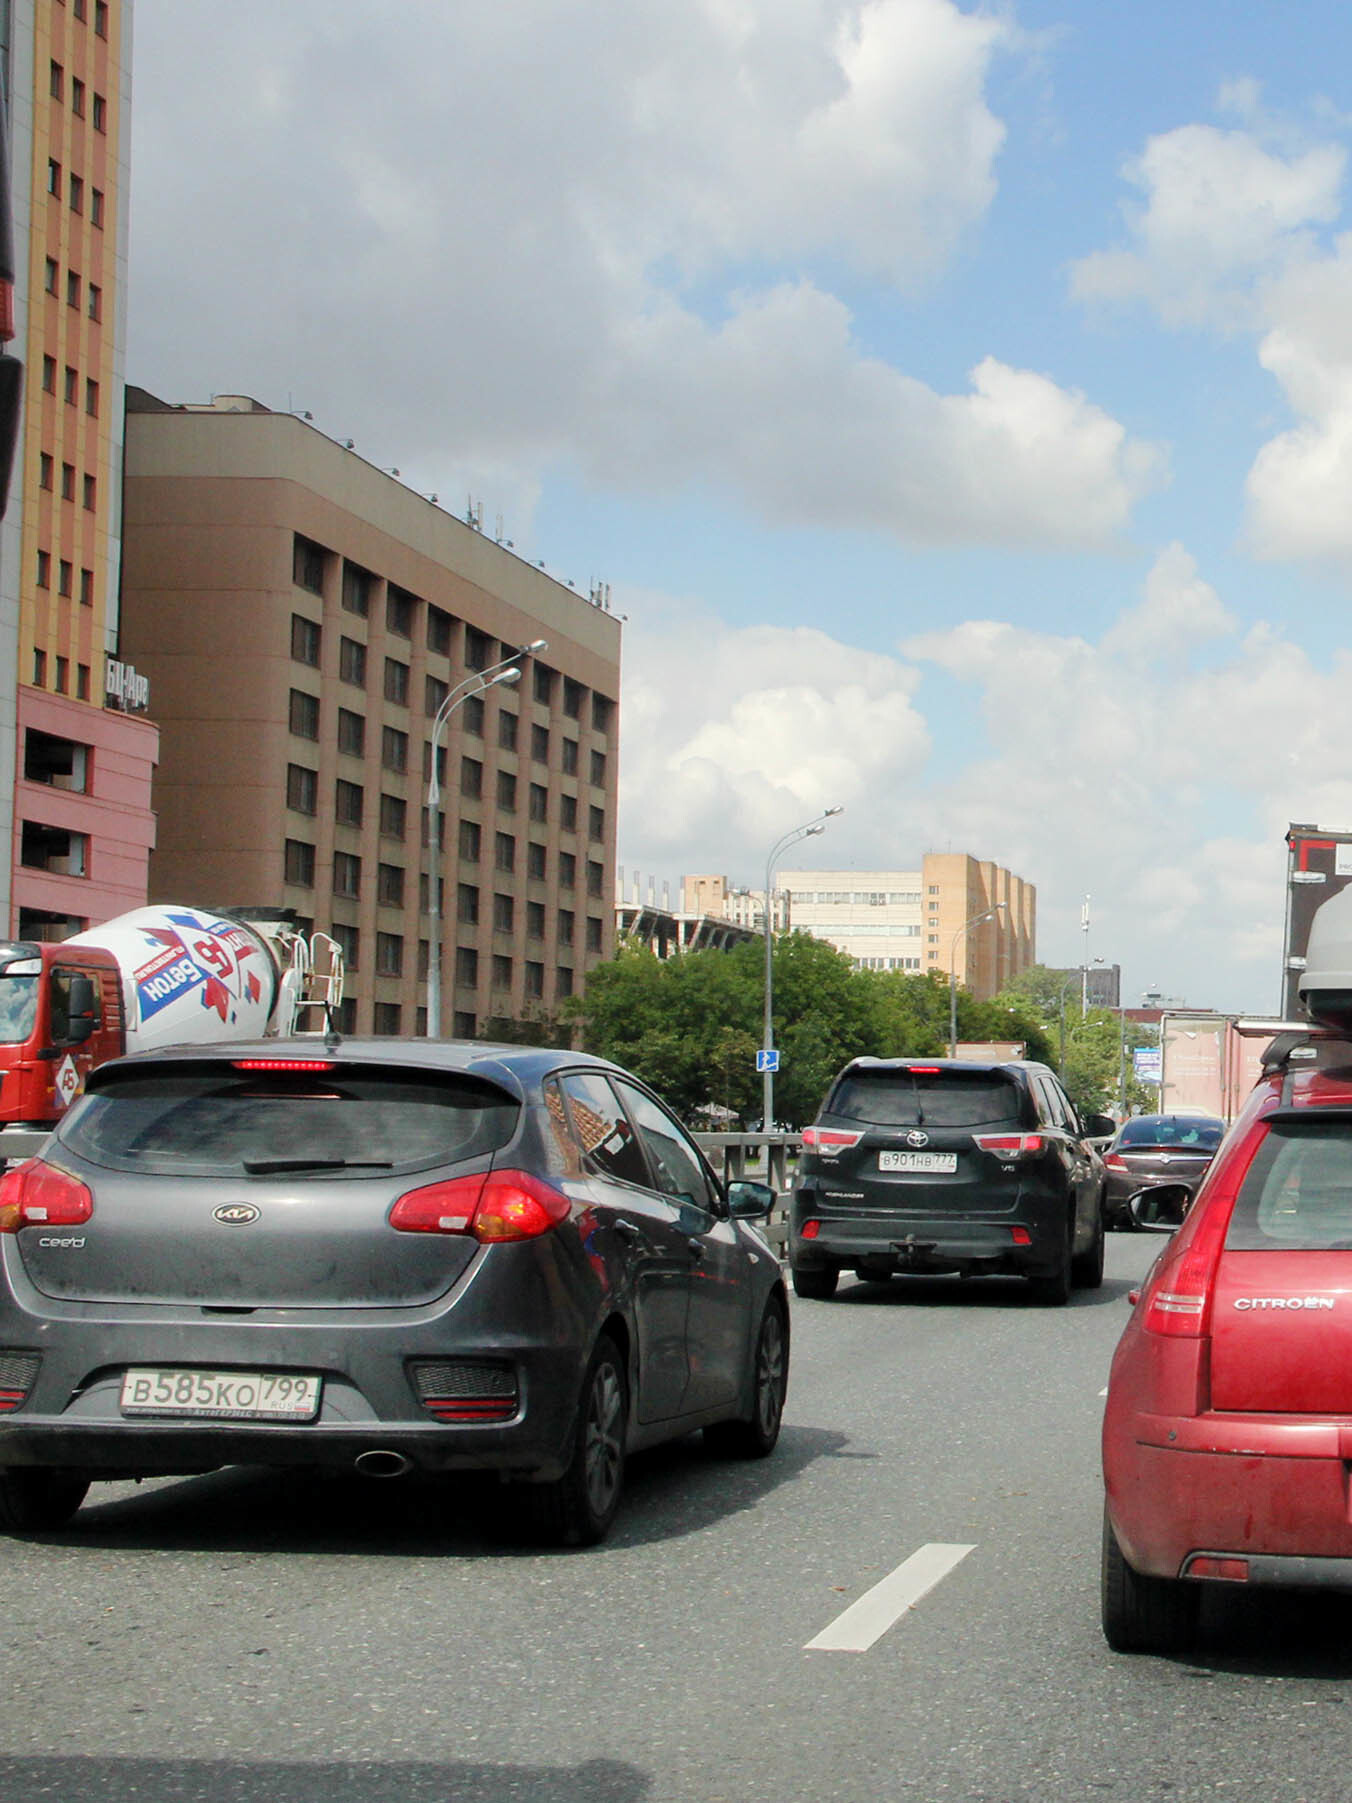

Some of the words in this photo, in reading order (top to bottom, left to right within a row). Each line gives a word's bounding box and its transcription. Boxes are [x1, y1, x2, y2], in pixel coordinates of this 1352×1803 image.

[884, 1153, 932, 1167] В901НВ
[934, 1153, 954, 1164] 777
[1233, 1296, 1335, 1310] CITROËN
[133, 1373, 255, 1407] В585КО
[263, 1376, 308, 1402] 799
[270, 1402, 293, 1410] RUS
